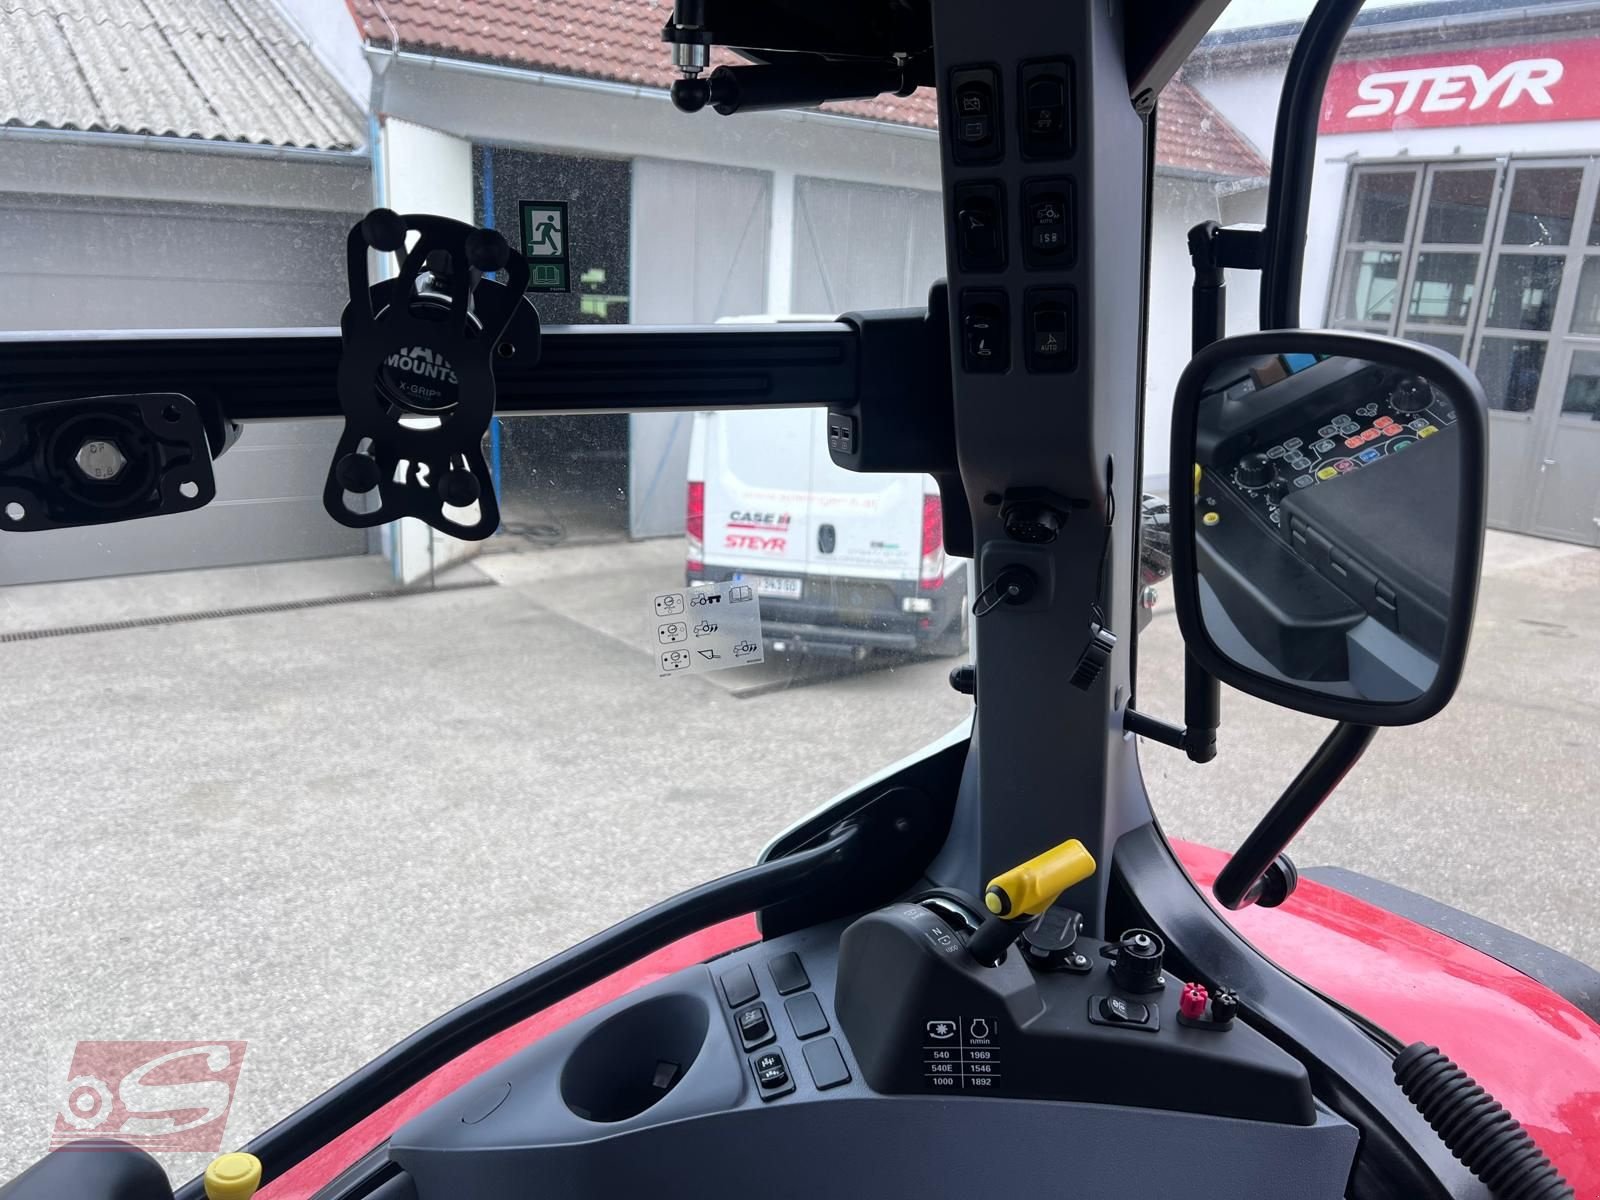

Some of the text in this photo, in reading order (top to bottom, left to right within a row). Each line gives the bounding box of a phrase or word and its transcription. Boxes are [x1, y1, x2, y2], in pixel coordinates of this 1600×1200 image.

[1345, 58, 1564, 118] STEYR
[384, 353, 458, 384] MOUNTS
[729, 510, 775, 524] CASE
[723, 534, 786, 551] STEYR
[969, 1037, 990, 1045] n/min
[933, 1051, 991, 1059] 540 1969
[931, 1064, 991, 1073] 540E 1546
[932, 1078, 992, 1086] 1000 1892
